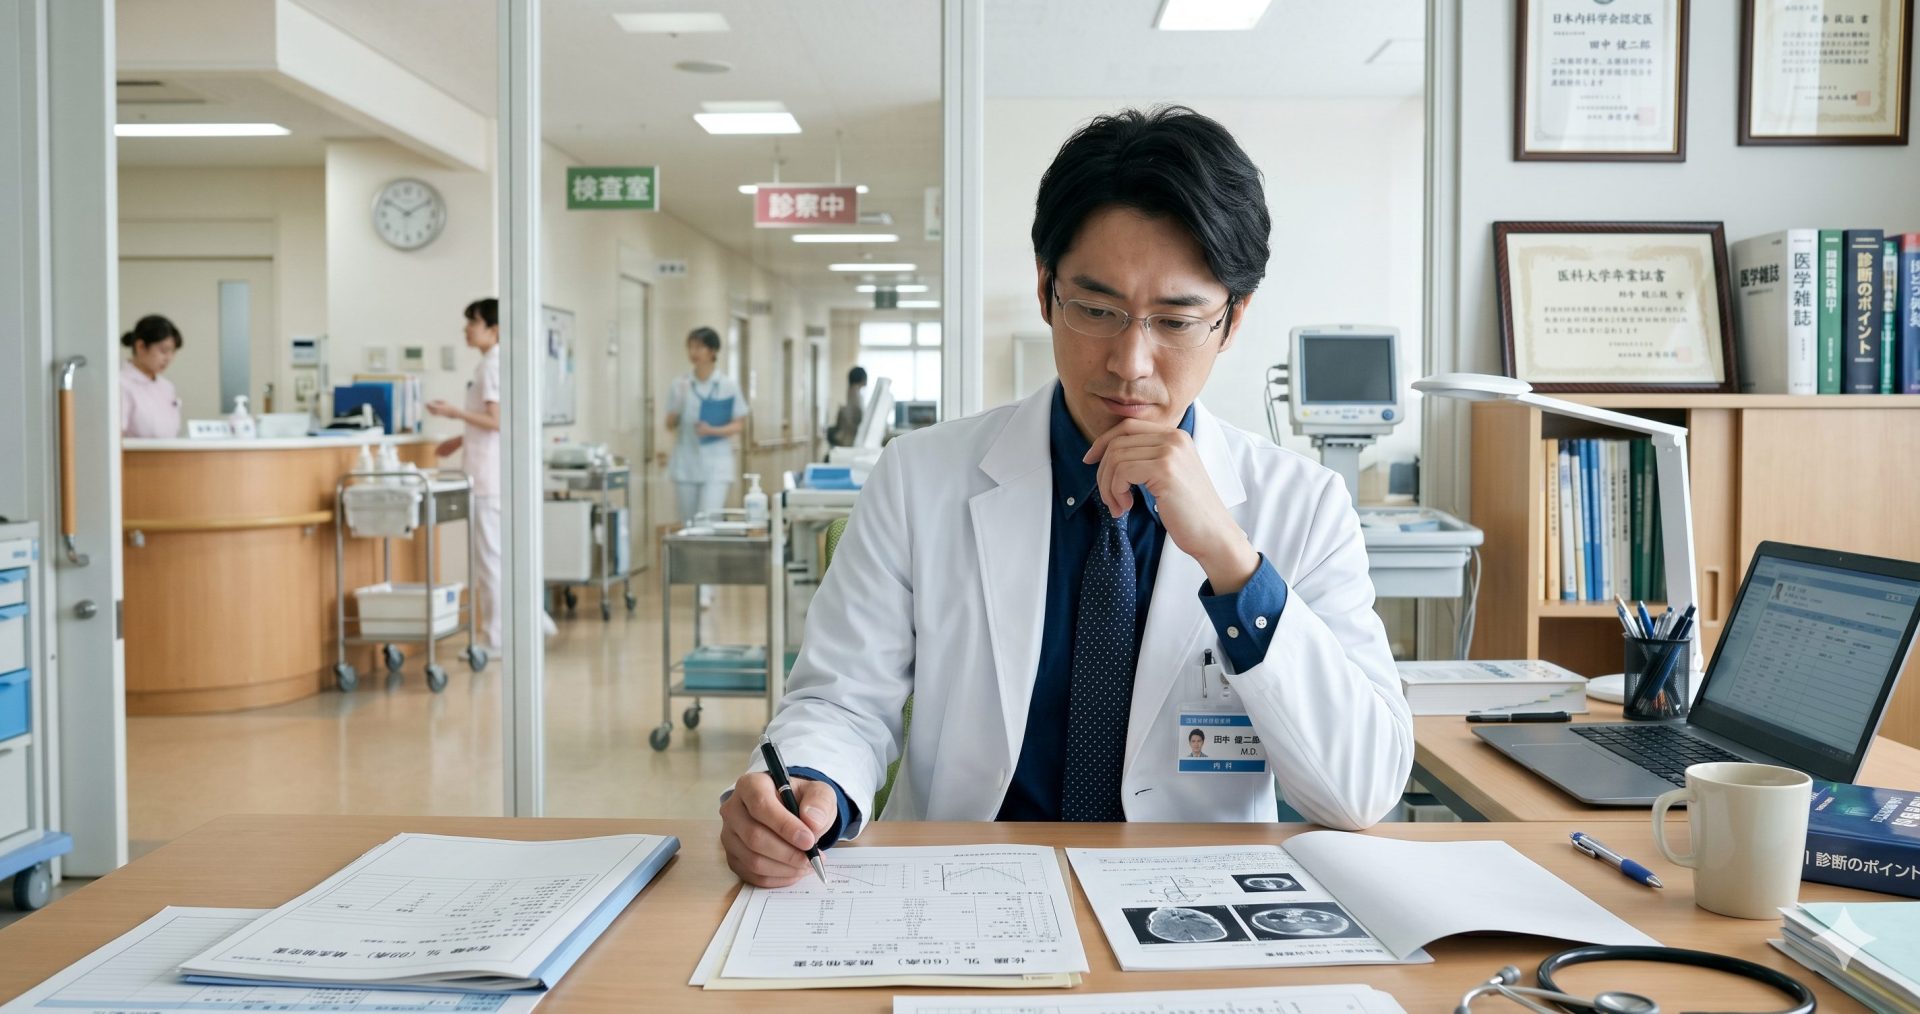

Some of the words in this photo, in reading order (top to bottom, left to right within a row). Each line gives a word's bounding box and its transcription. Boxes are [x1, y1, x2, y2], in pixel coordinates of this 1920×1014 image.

[1553, 12, 1653, 25] 日本内科学会認定医
[1589, 40, 1611, 50] 田中
[1616, 39, 1652, 50] 健二郎
[573, 175, 650, 202] 検査室
[768, 192, 845, 219] 診察中
[1558, 268, 1667, 283] 医科大学卒業証書
[1740, 264, 1780, 289] 医学雑誌
[1793, 252, 1812, 327] 医学雑誌
[1857, 252, 1873, 355] 診断のポイント
[1240, 747, 1258, 756] M.D.
[1816, 851, 1920, 880] 診断のポイント
